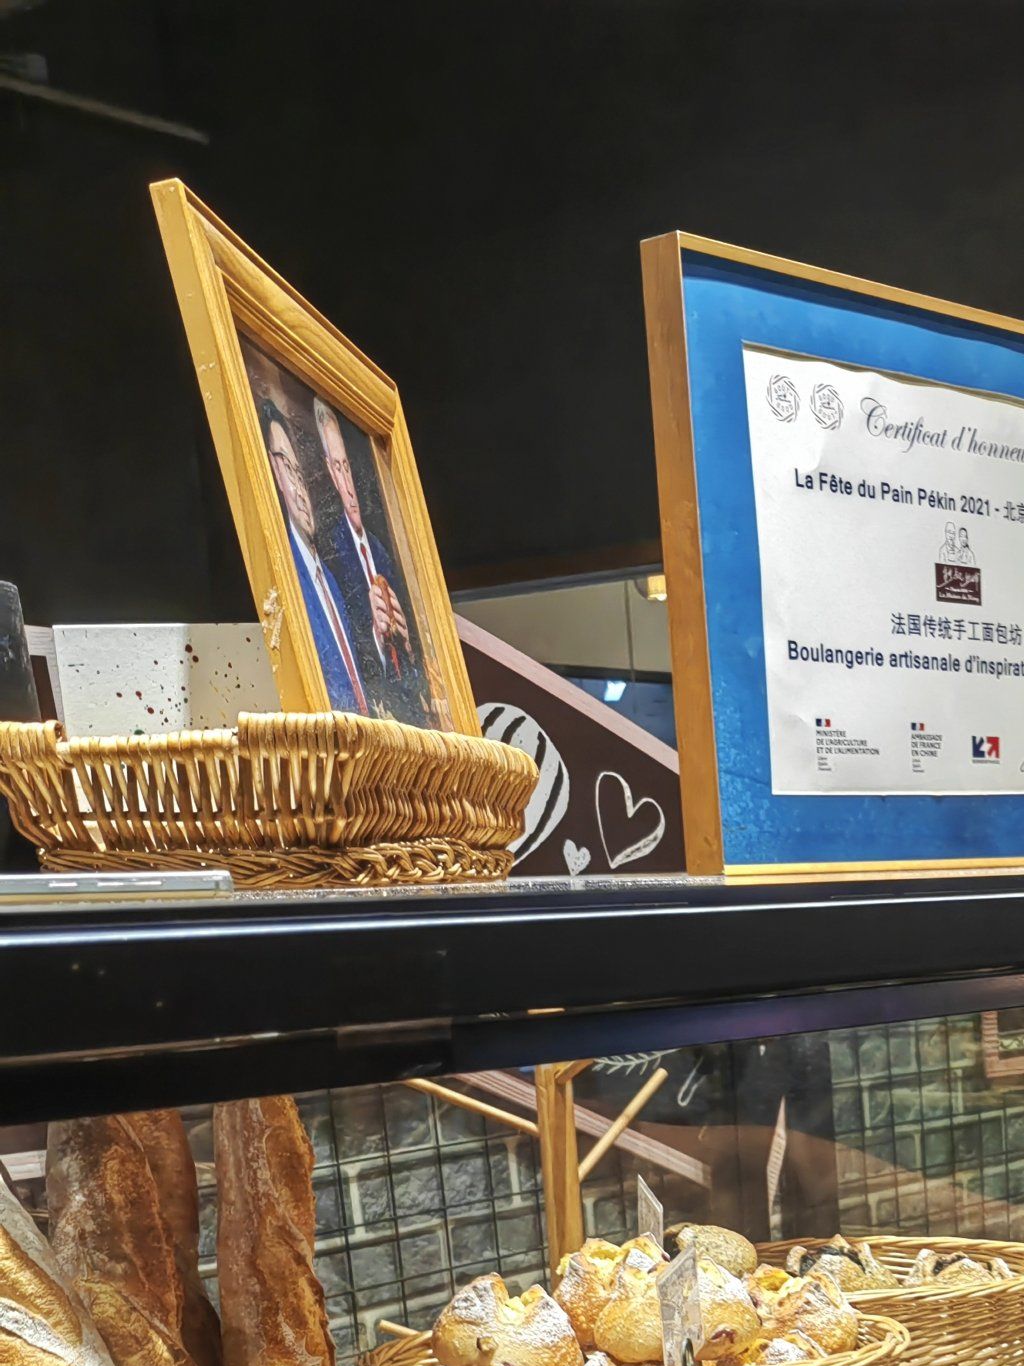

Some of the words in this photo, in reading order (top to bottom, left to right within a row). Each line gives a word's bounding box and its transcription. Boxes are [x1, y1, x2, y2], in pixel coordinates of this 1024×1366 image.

[860, 397, 947, 453] Certificat
[794, 468, 814, 490] La
[819, 472, 853, 496] Fête
[858, 479, 876, 499] du
[880, 482, 913, 505] Pain
[918, 487, 956, 511] Pékin
[960, 495, 990, 516] 2021
[891, 612, 1023, 647] 法国传统手工面包坊
[788, 640, 884, 669] Boulangerie
[889, 650, 961, 672] artisanale
